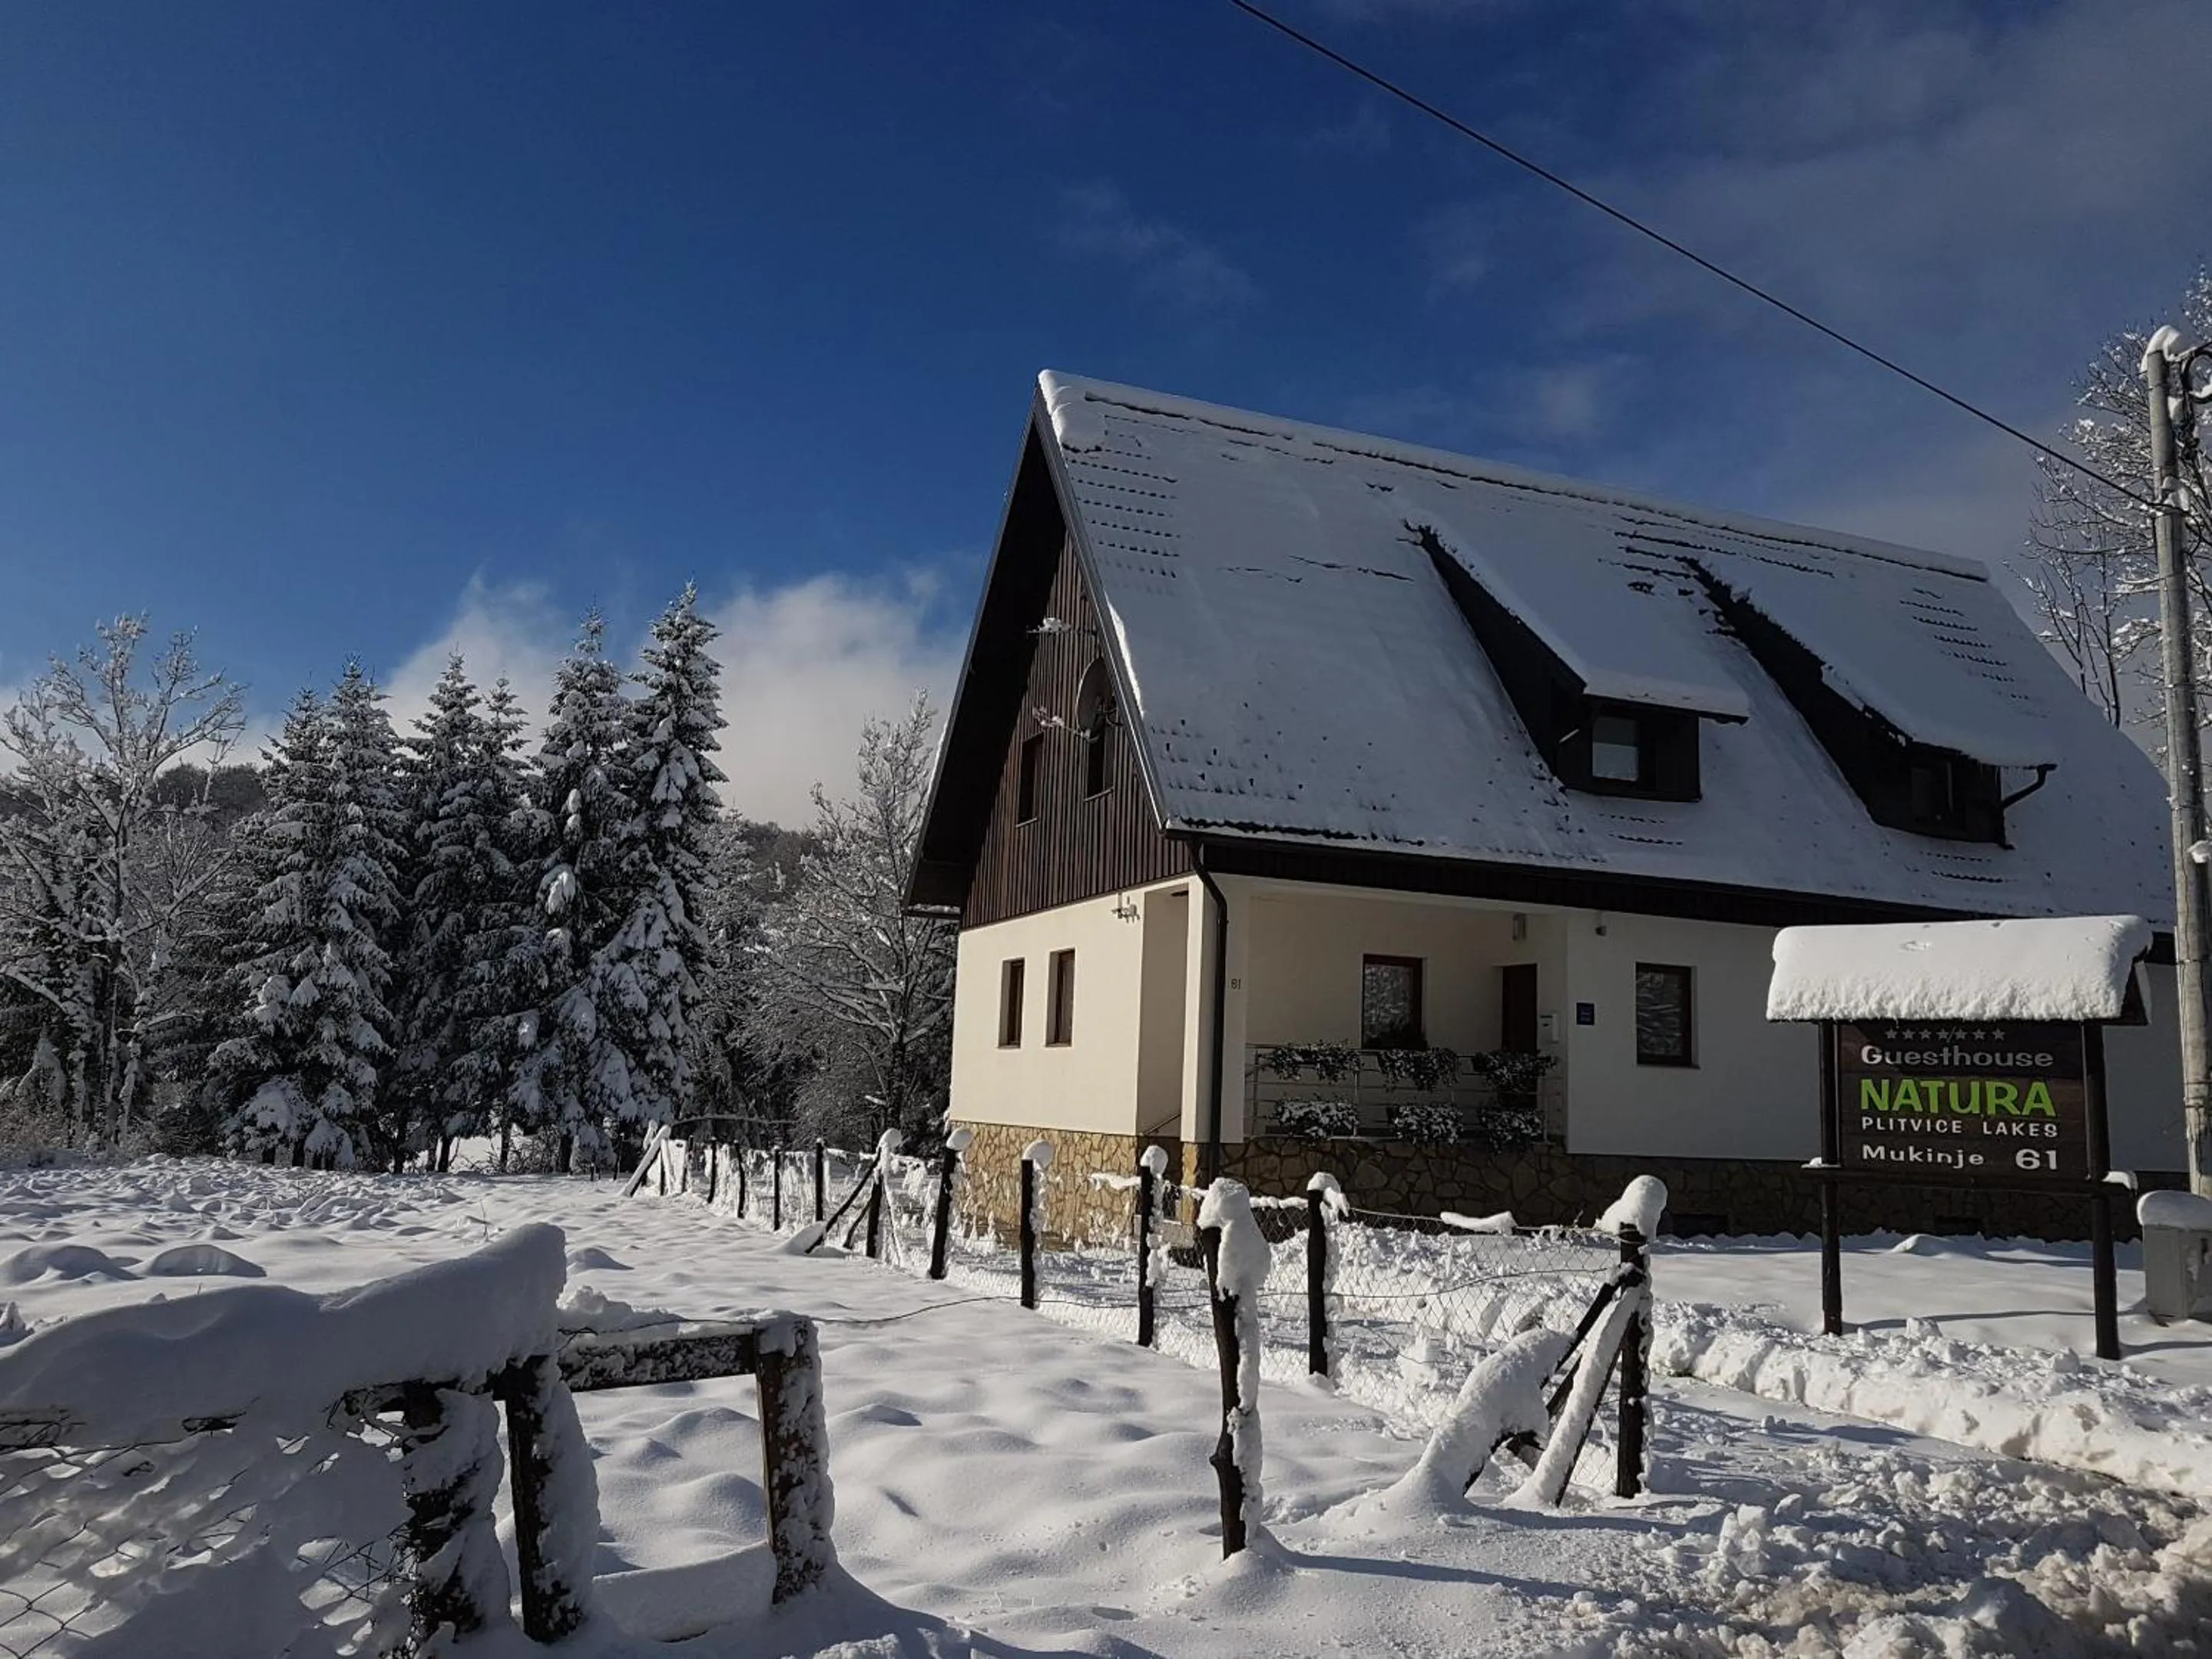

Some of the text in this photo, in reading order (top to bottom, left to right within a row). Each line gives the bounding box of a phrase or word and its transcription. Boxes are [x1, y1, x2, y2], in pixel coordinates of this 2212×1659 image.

[1861, 1045, 2054, 1067] Guesthouse
[1860, 1078, 2056, 1116] NATURA
[1862, 1117, 2058, 1137] PLITVICE LAKES
[1863, 1144, 2058, 1170] Mukinje 61
